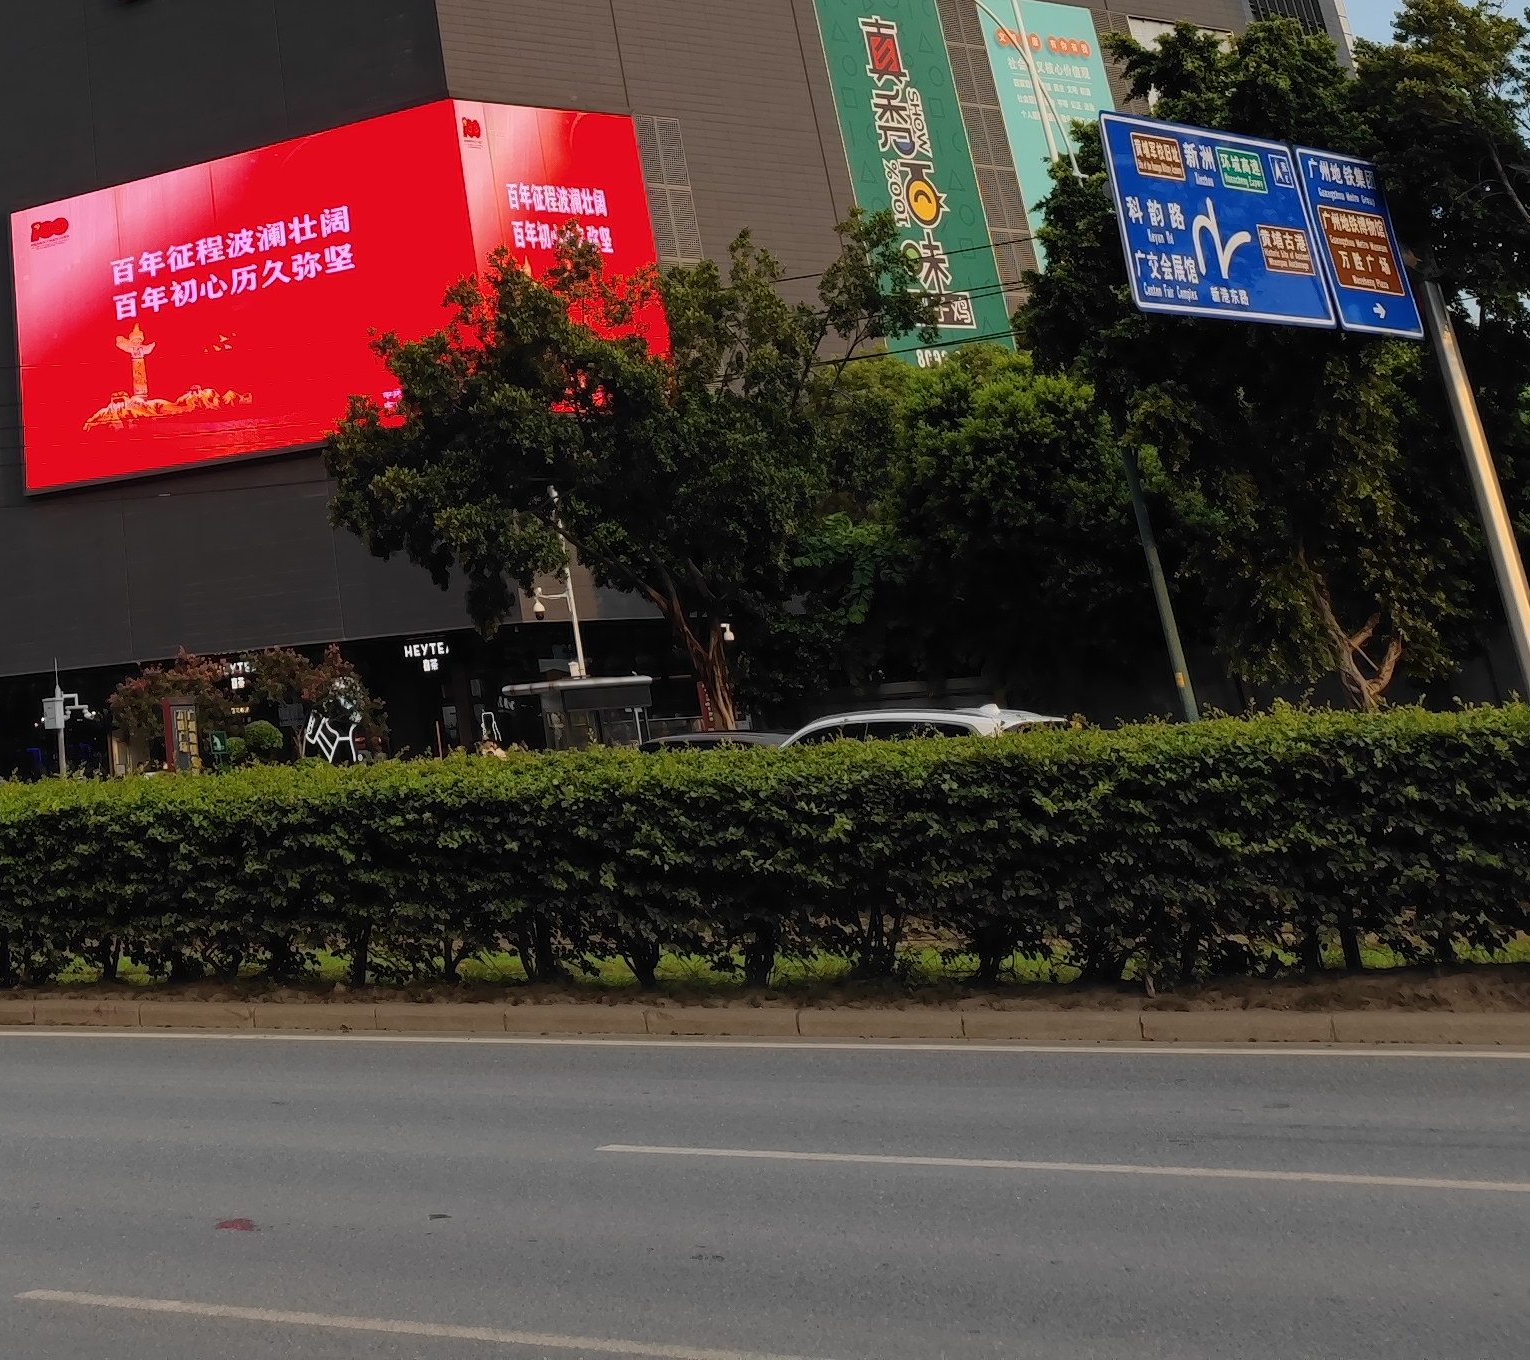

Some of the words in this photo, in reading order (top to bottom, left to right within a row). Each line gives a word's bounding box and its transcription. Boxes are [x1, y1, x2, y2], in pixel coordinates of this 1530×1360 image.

[1006, 56, 1091, 80] 社会义核心价值观
[905, 86, 933, 158] SHOW
[1182, 142, 1217, 172] 新洲
[1219, 153, 1261, 176] 环城高速
[1308, 157, 1376, 190] 广州地铁集团
[506, 182, 608, 218] 百年征程波澜壮阔
[882, 158, 911, 228] 100%
[1125, 196, 1186, 231] 科韵路
[1321, 210, 1386, 239] 广州地铁博物馆
[110, 205, 351, 286] 百年征程波澜壮阔
[1260, 229, 1307, 252] 黄埔古港
[1135, 249, 1199, 284] 广交会展馆
[1337, 250, 1392, 276] 万胜广场
[113, 243, 356, 322] 百年初心历久弥坚
[1210, 285, 1250, 306] 新港东路
